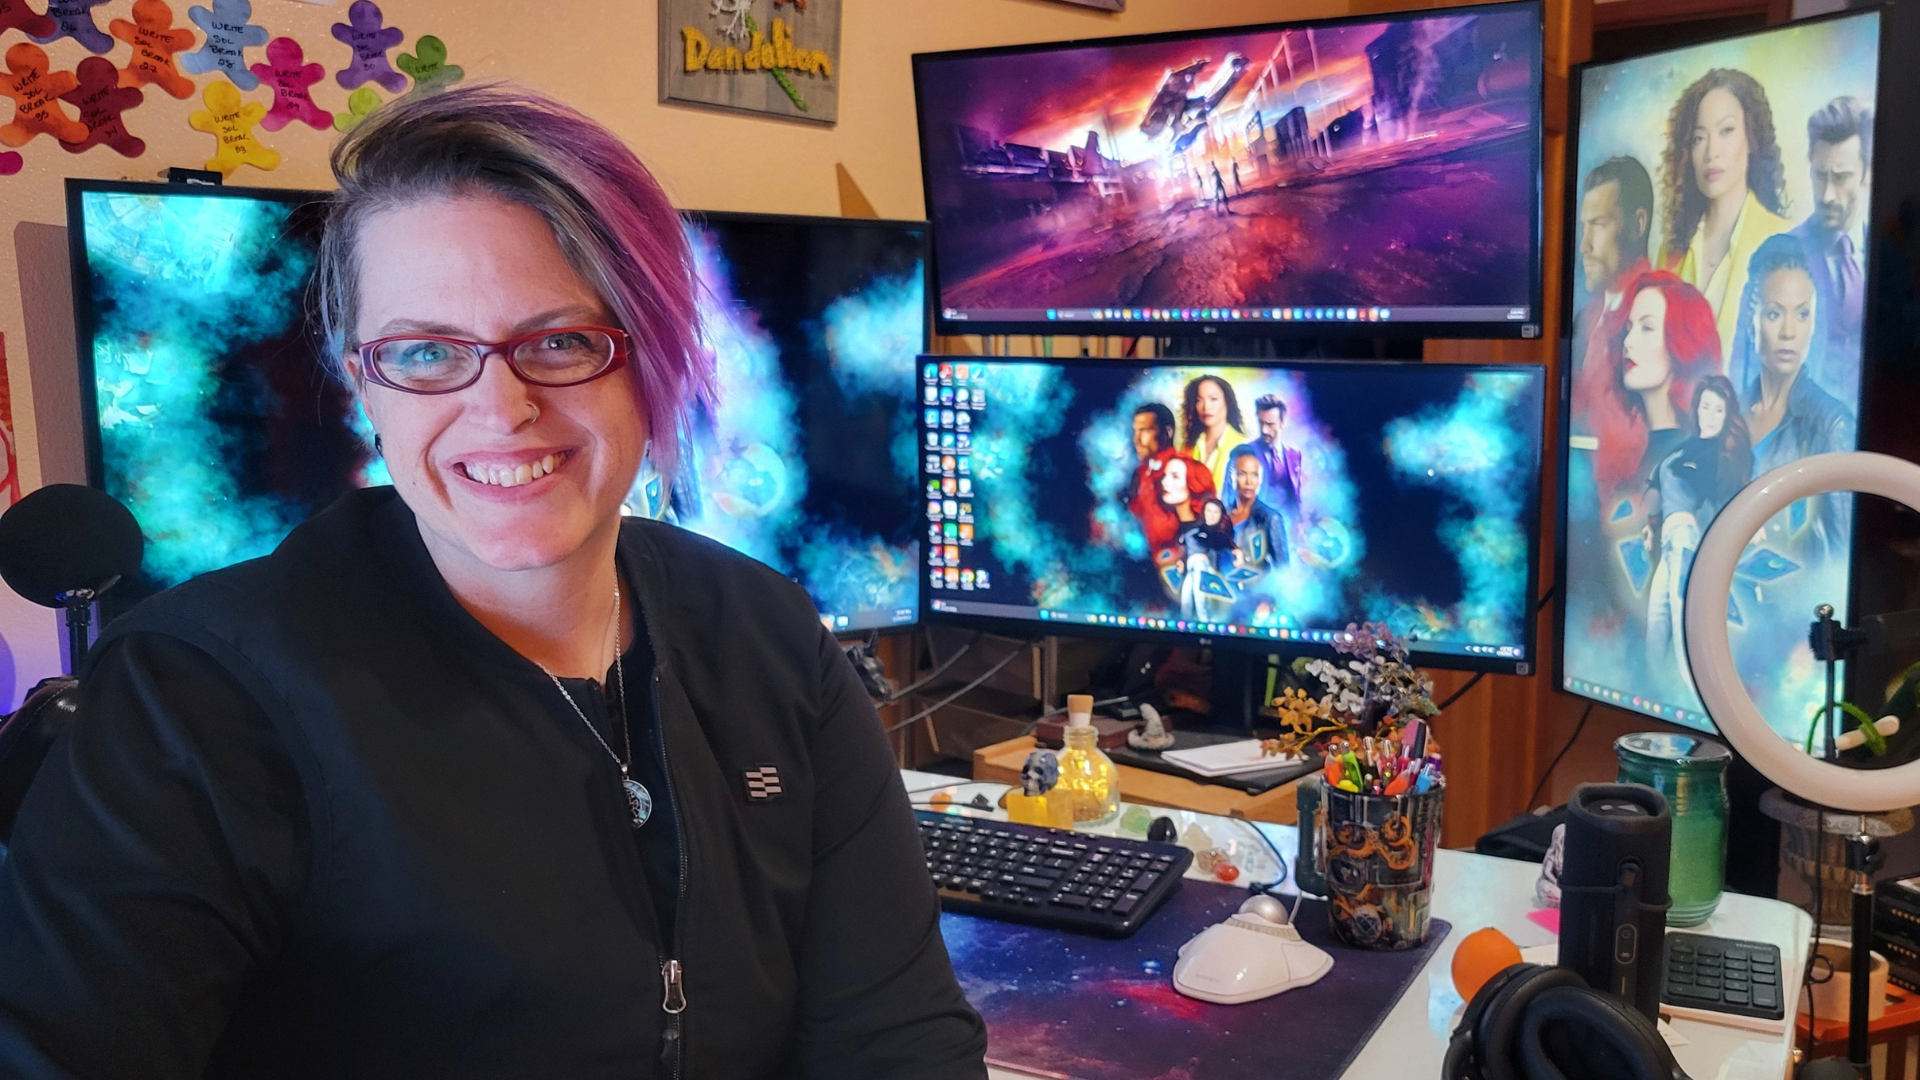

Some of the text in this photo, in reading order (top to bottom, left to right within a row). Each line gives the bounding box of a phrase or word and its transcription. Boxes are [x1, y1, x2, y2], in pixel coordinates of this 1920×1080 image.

[212, 21, 244, 34] WRITE
[138, 27, 174, 43] WRITE
[352, 31, 377, 41] WRITE
[209, 44, 243, 57] BREAK
[681, 18, 832, 76] Dandelion
[141, 49, 170, 67] BREAK
[275, 69, 303, 78] WRITE
[415, 61, 438, 73] WRITE
[13, 67, 40, 92] WRITE
[82, 86, 110, 106] WRITE
[280, 89, 308, 100] BREAK
[19, 94, 55, 114] BREAK
[35, 110, 49, 121] 35
[214, 111, 241, 124] WRITE
[223, 133, 250, 144] BREAK
